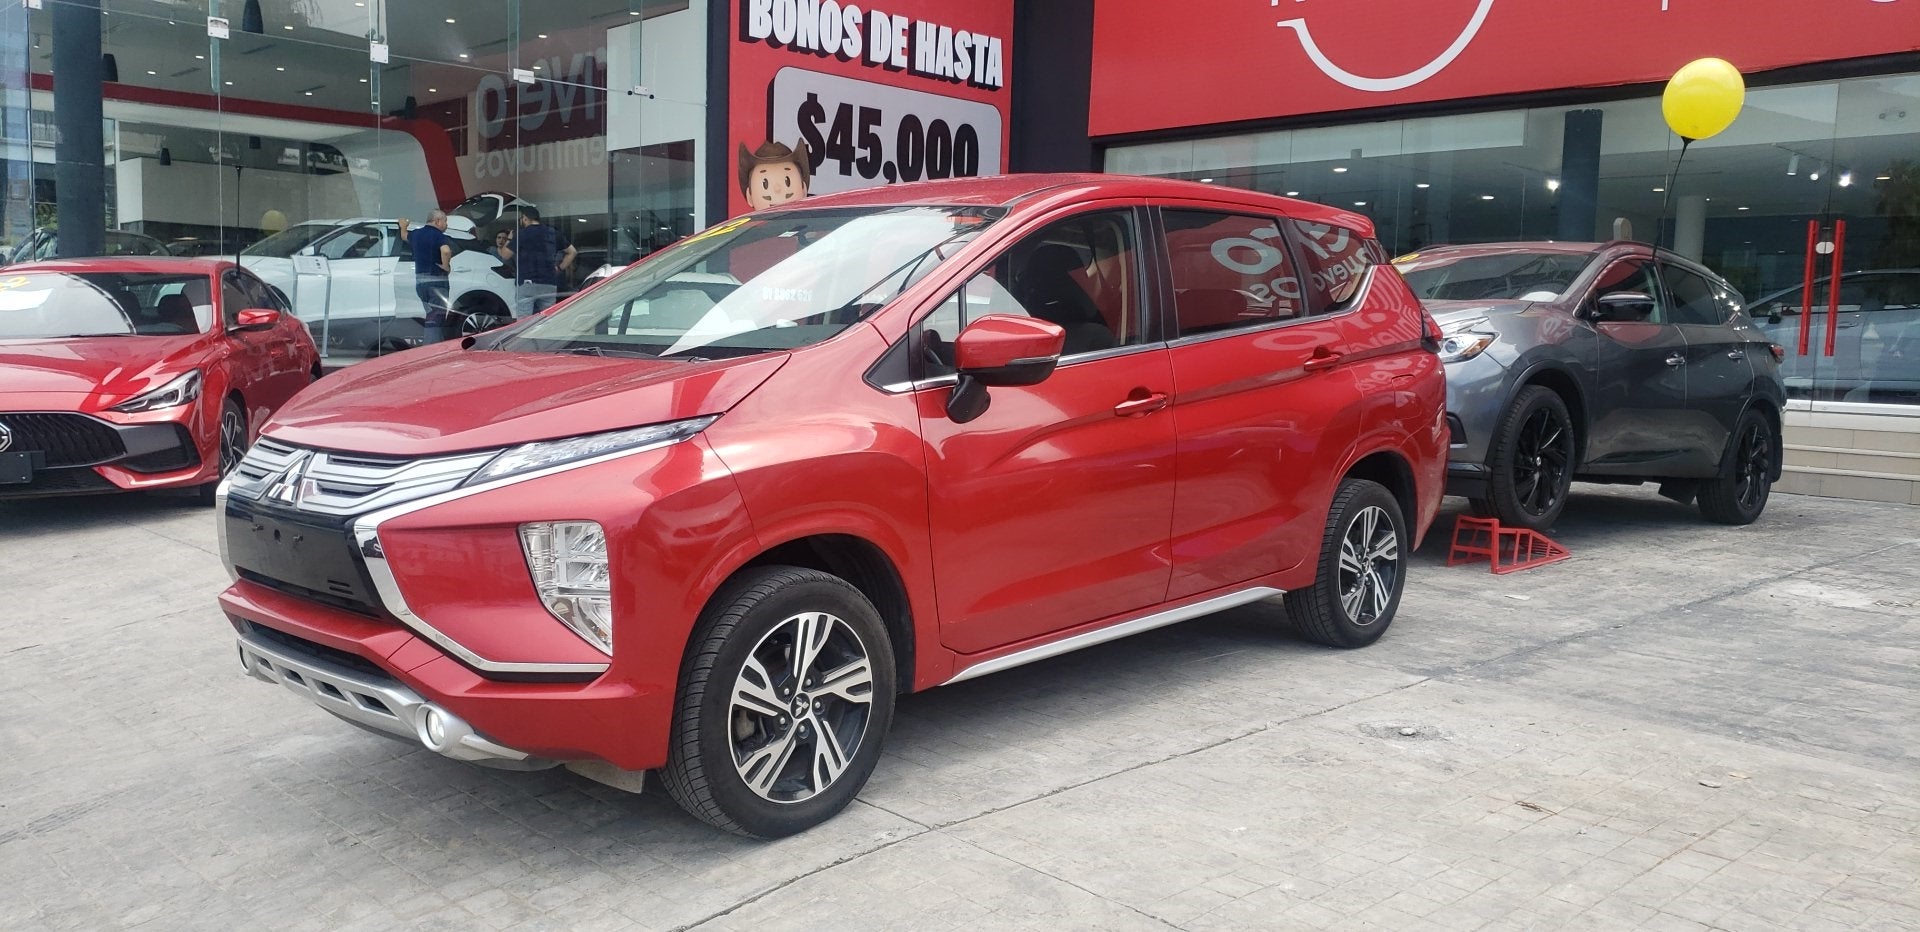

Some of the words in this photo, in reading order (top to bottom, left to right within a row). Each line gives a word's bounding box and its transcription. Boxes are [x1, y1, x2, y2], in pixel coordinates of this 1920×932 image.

[748, 0, 863, 58] BONOS
[869, 9, 908, 68] DE
[914, 20, 1004, 88] HASTA
[797, 92, 980, 184] $45,000
